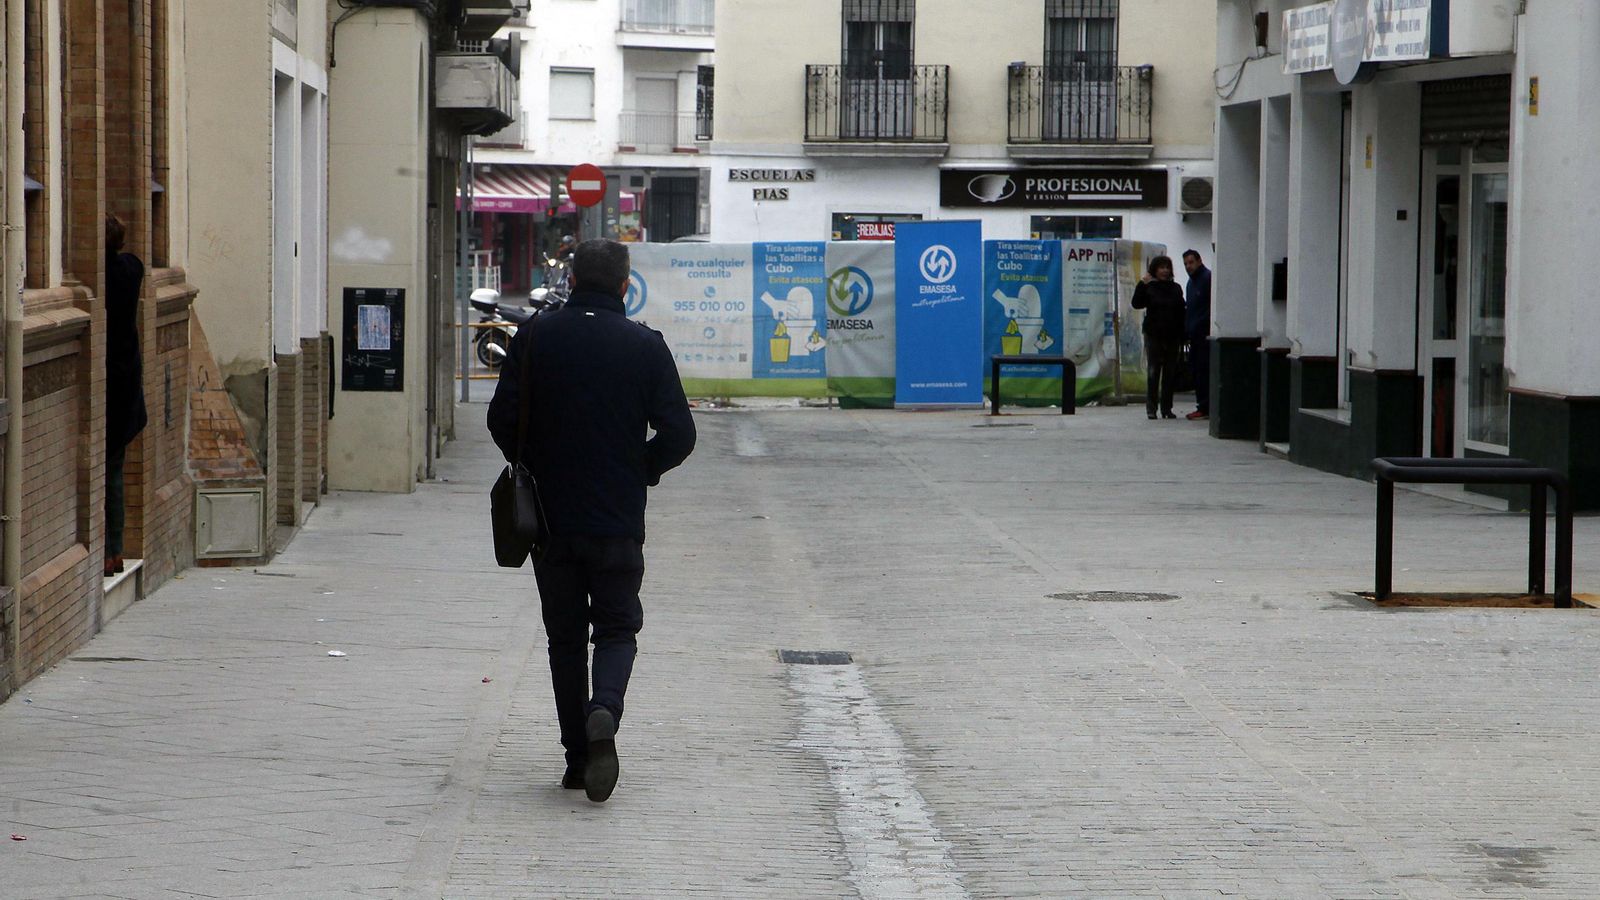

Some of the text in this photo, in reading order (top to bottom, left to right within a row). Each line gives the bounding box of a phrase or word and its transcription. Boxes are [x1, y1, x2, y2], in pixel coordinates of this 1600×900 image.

[729, 169, 815, 181] ESCUELAS
[1025, 178, 1143, 192] PROFESIONAL
[753, 188, 789, 200] PIAS
[859, 223, 894, 237] REBAJAS
[766, 244, 818, 254] Tira siempre
[997, 241, 1043, 251] Tira siempre
[765, 254, 778, 262] las
[780, 253, 817, 263] Toallitas
[997, 251, 1008, 260] las
[1010, 251, 1042, 260] Toallitas
[1068, 248, 1112, 262] APP mi
[671, 257, 745, 269] Para cualquier
[765, 263, 794, 273] Cubo
[997, 260, 1023, 270] Cubo
[687, 269, 731, 278] consulta
[1001, 272, 1020, 281] Evita
[919, 284, 957, 294] EMASESA
[673, 300, 745, 312] 955 010 010
[827, 319, 874, 330] EMASESA
